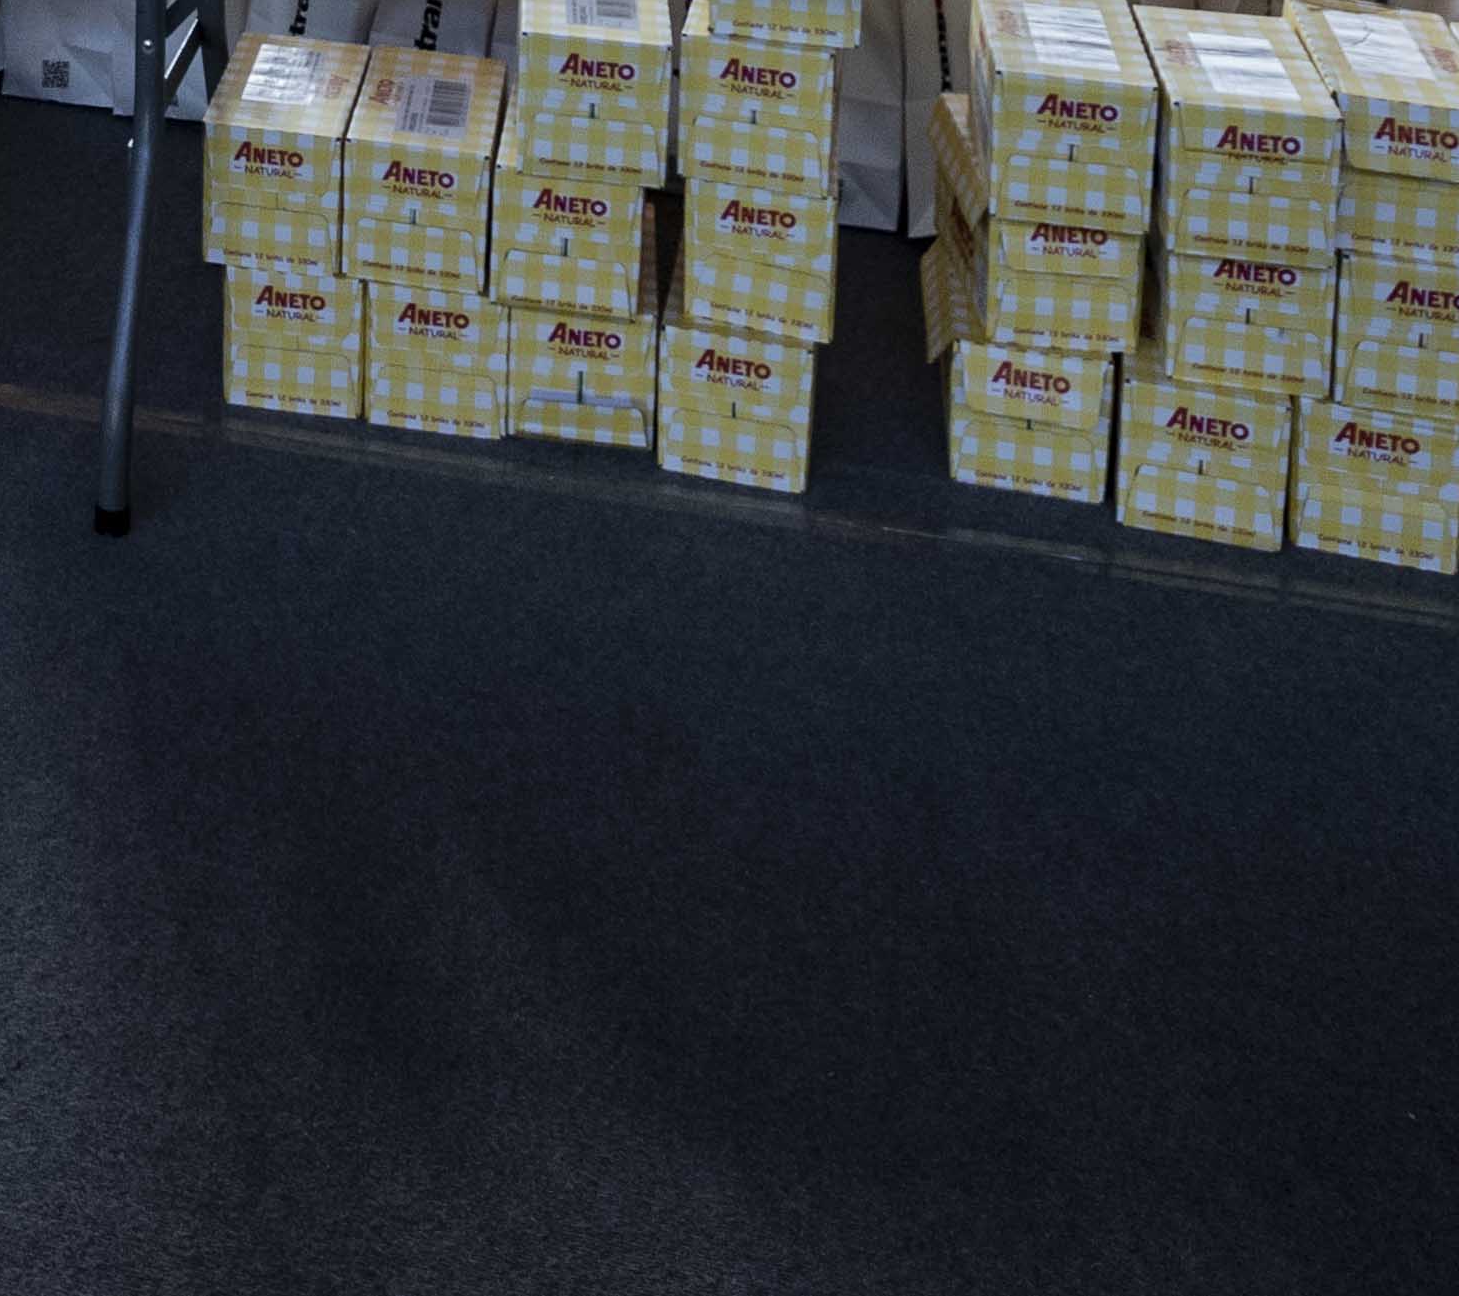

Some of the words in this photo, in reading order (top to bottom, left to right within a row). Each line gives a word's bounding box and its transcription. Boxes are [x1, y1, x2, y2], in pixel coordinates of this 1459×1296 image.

[560, 53, 635, 81] ANETO
[720, 58, 796, 88] ANETO
[569, 77, 624, 92] NATURAL
[1037, 92, 1119, 122] ANETO
[1215, 124, 1301, 157] ANETO
[1374, 116, 1459, 151] ANETO
[236, 141, 304, 168] ANETO
[383, 160, 454, 189] ANETO
[533, 188, 607, 217] ANETO
[720, 201, 796, 229] ANETO
[1028, 222, 1107, 246] ANETO
[1213, 257, 1297, 287] ANETO
[255, 286, 326, 312] ANETO
[398, 301, 470, 329] ANETO
[548, 322, 622, 351] ANETO
[695, 348, 772, 380] ANETO
[991, 359, 1071, 395] ANETO
[1167, 406, 1250, 441] ANETO
[1334, 422, 1420, 454] ANETO
